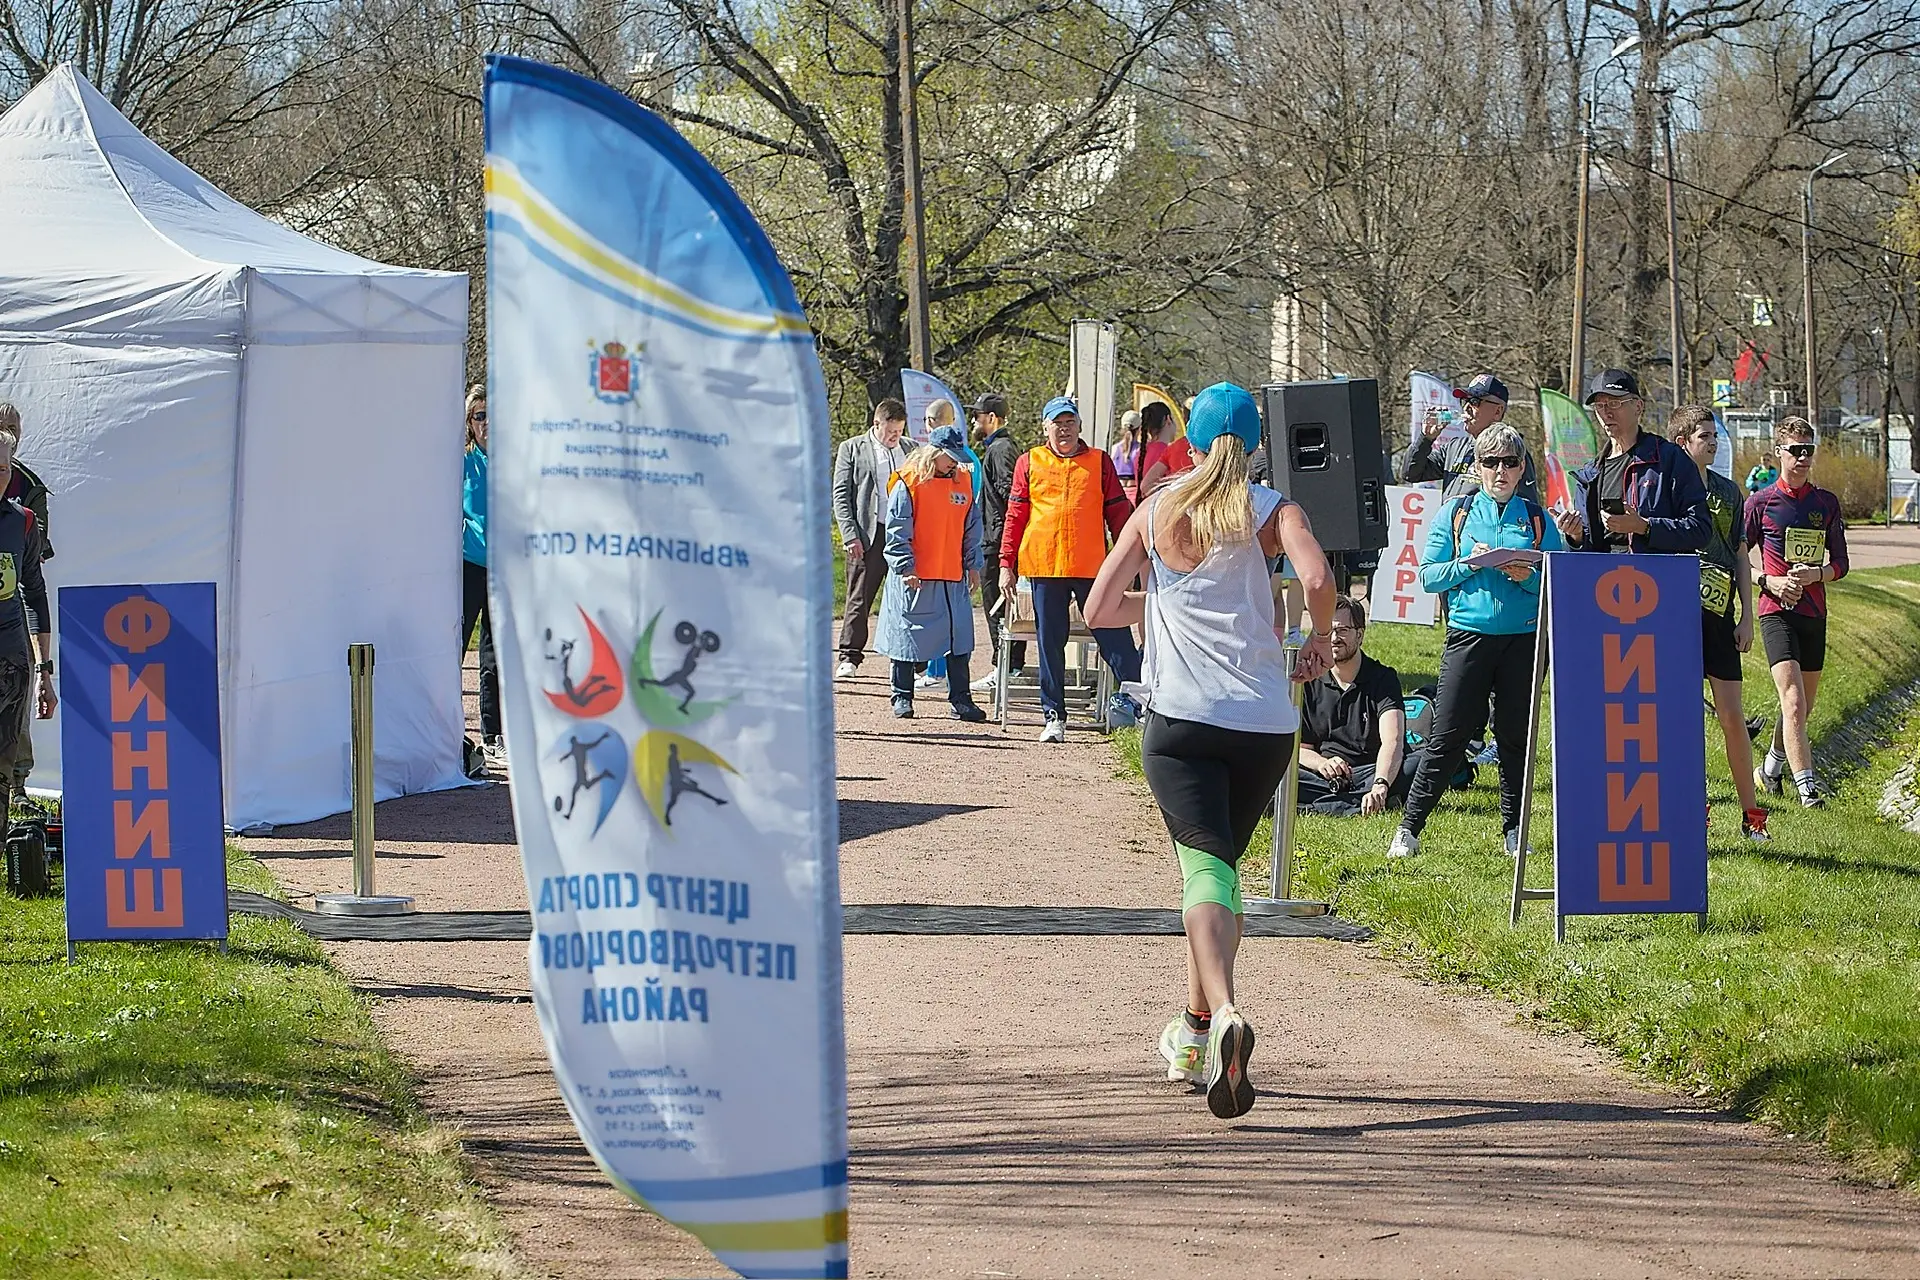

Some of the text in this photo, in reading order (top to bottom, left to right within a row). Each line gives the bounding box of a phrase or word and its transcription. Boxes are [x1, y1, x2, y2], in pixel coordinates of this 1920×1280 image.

[1393, 493, 1425, 618] СТАРТ
[1700, 583, 1727, 608] 025
[1794, 544, 1817, 558] 027
[103, 595, 185, 928] ФИНИШ
[1594, 565, 1671, 902] ФИНИШ
